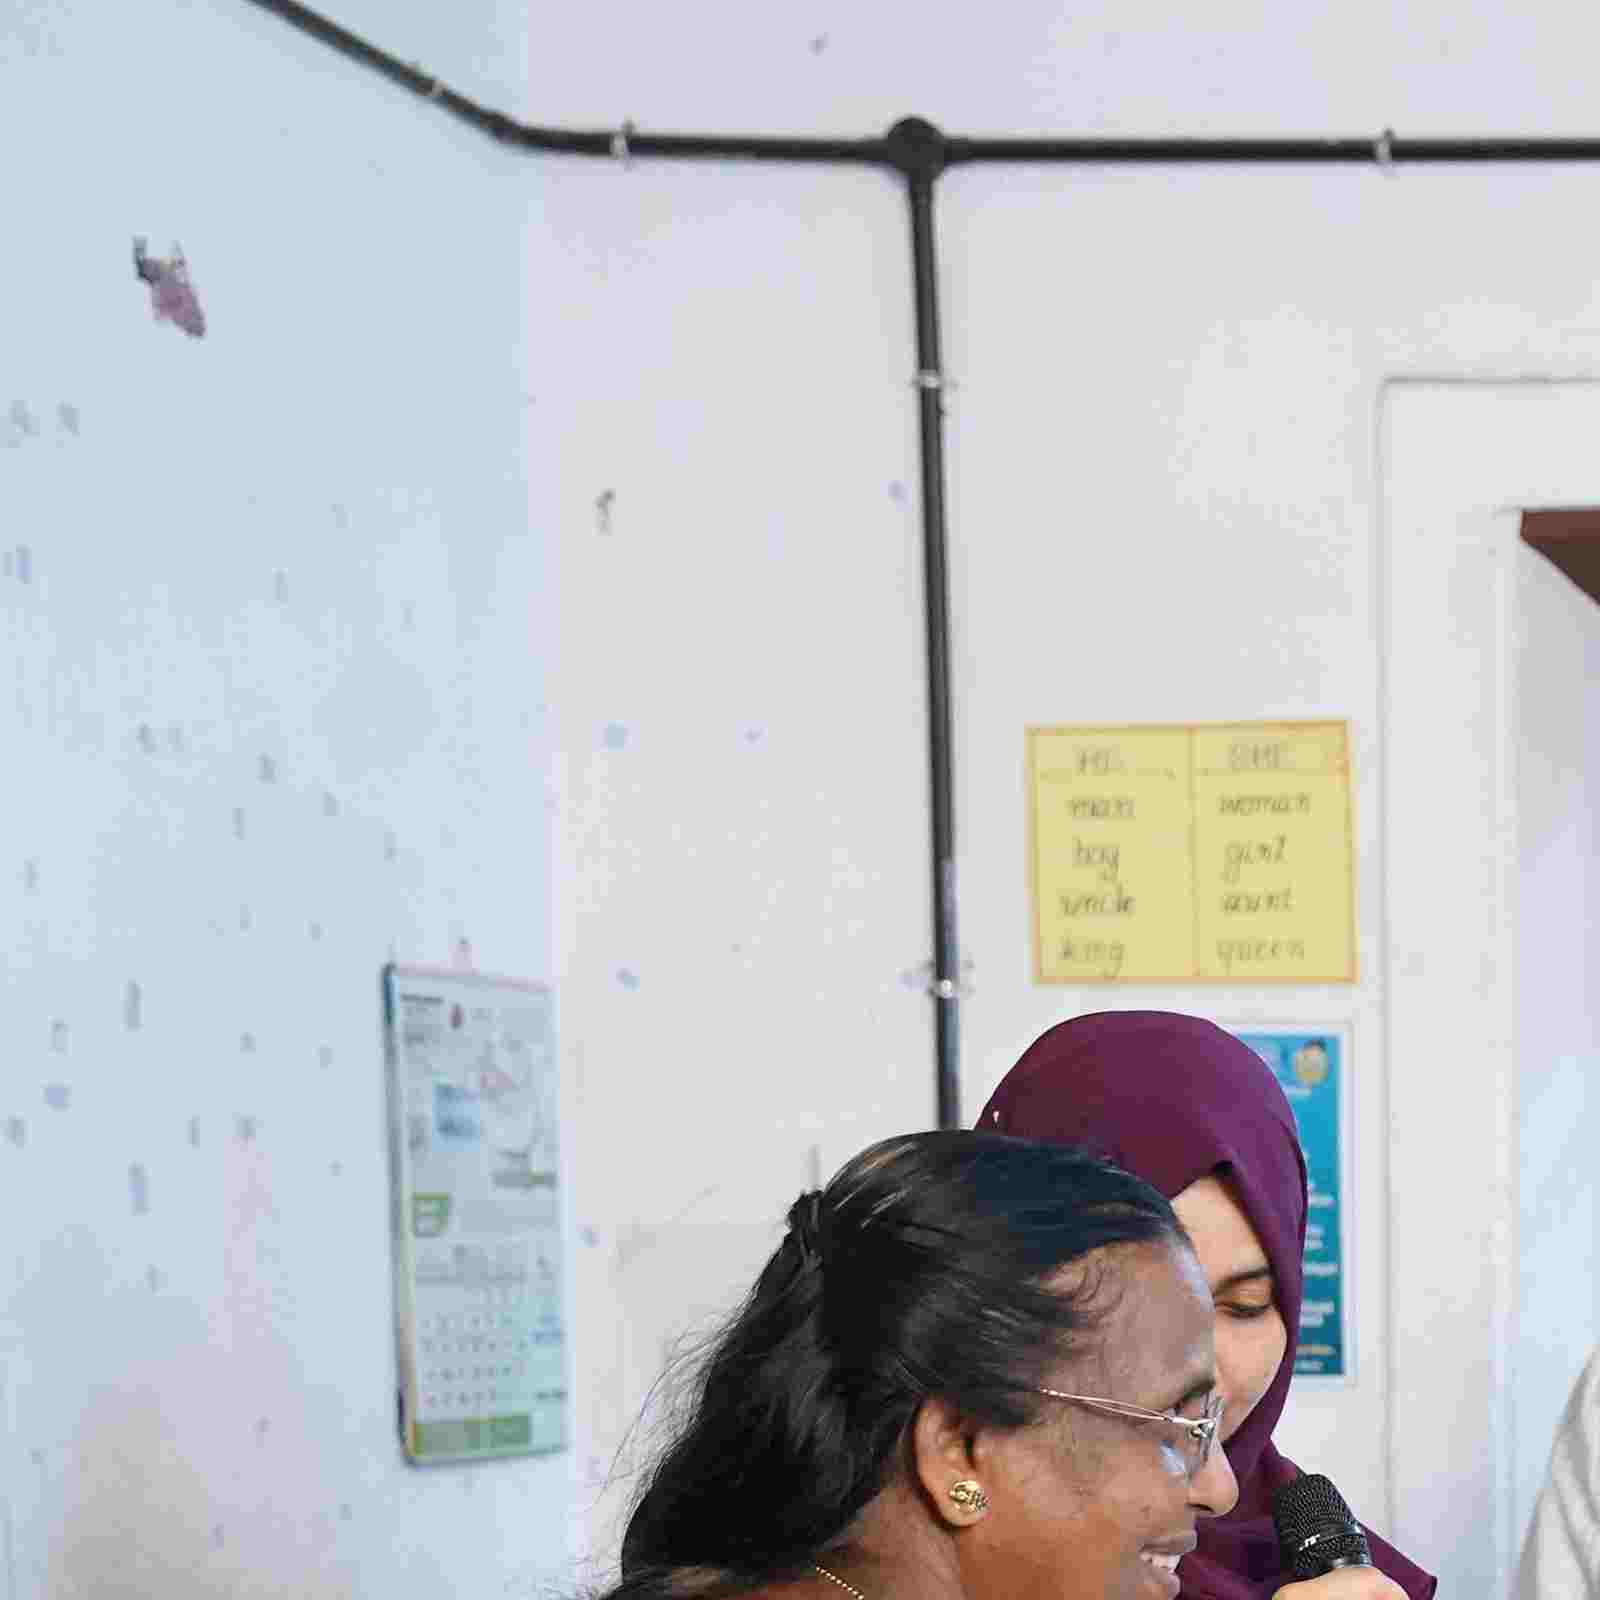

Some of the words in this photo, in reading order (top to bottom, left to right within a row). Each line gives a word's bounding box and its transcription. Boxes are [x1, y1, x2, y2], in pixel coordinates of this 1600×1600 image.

[1217, 793, 1312, 816] woman
[1074, 835, 1120, 883] boy
[1223, 886, 1293, 913] aunt
